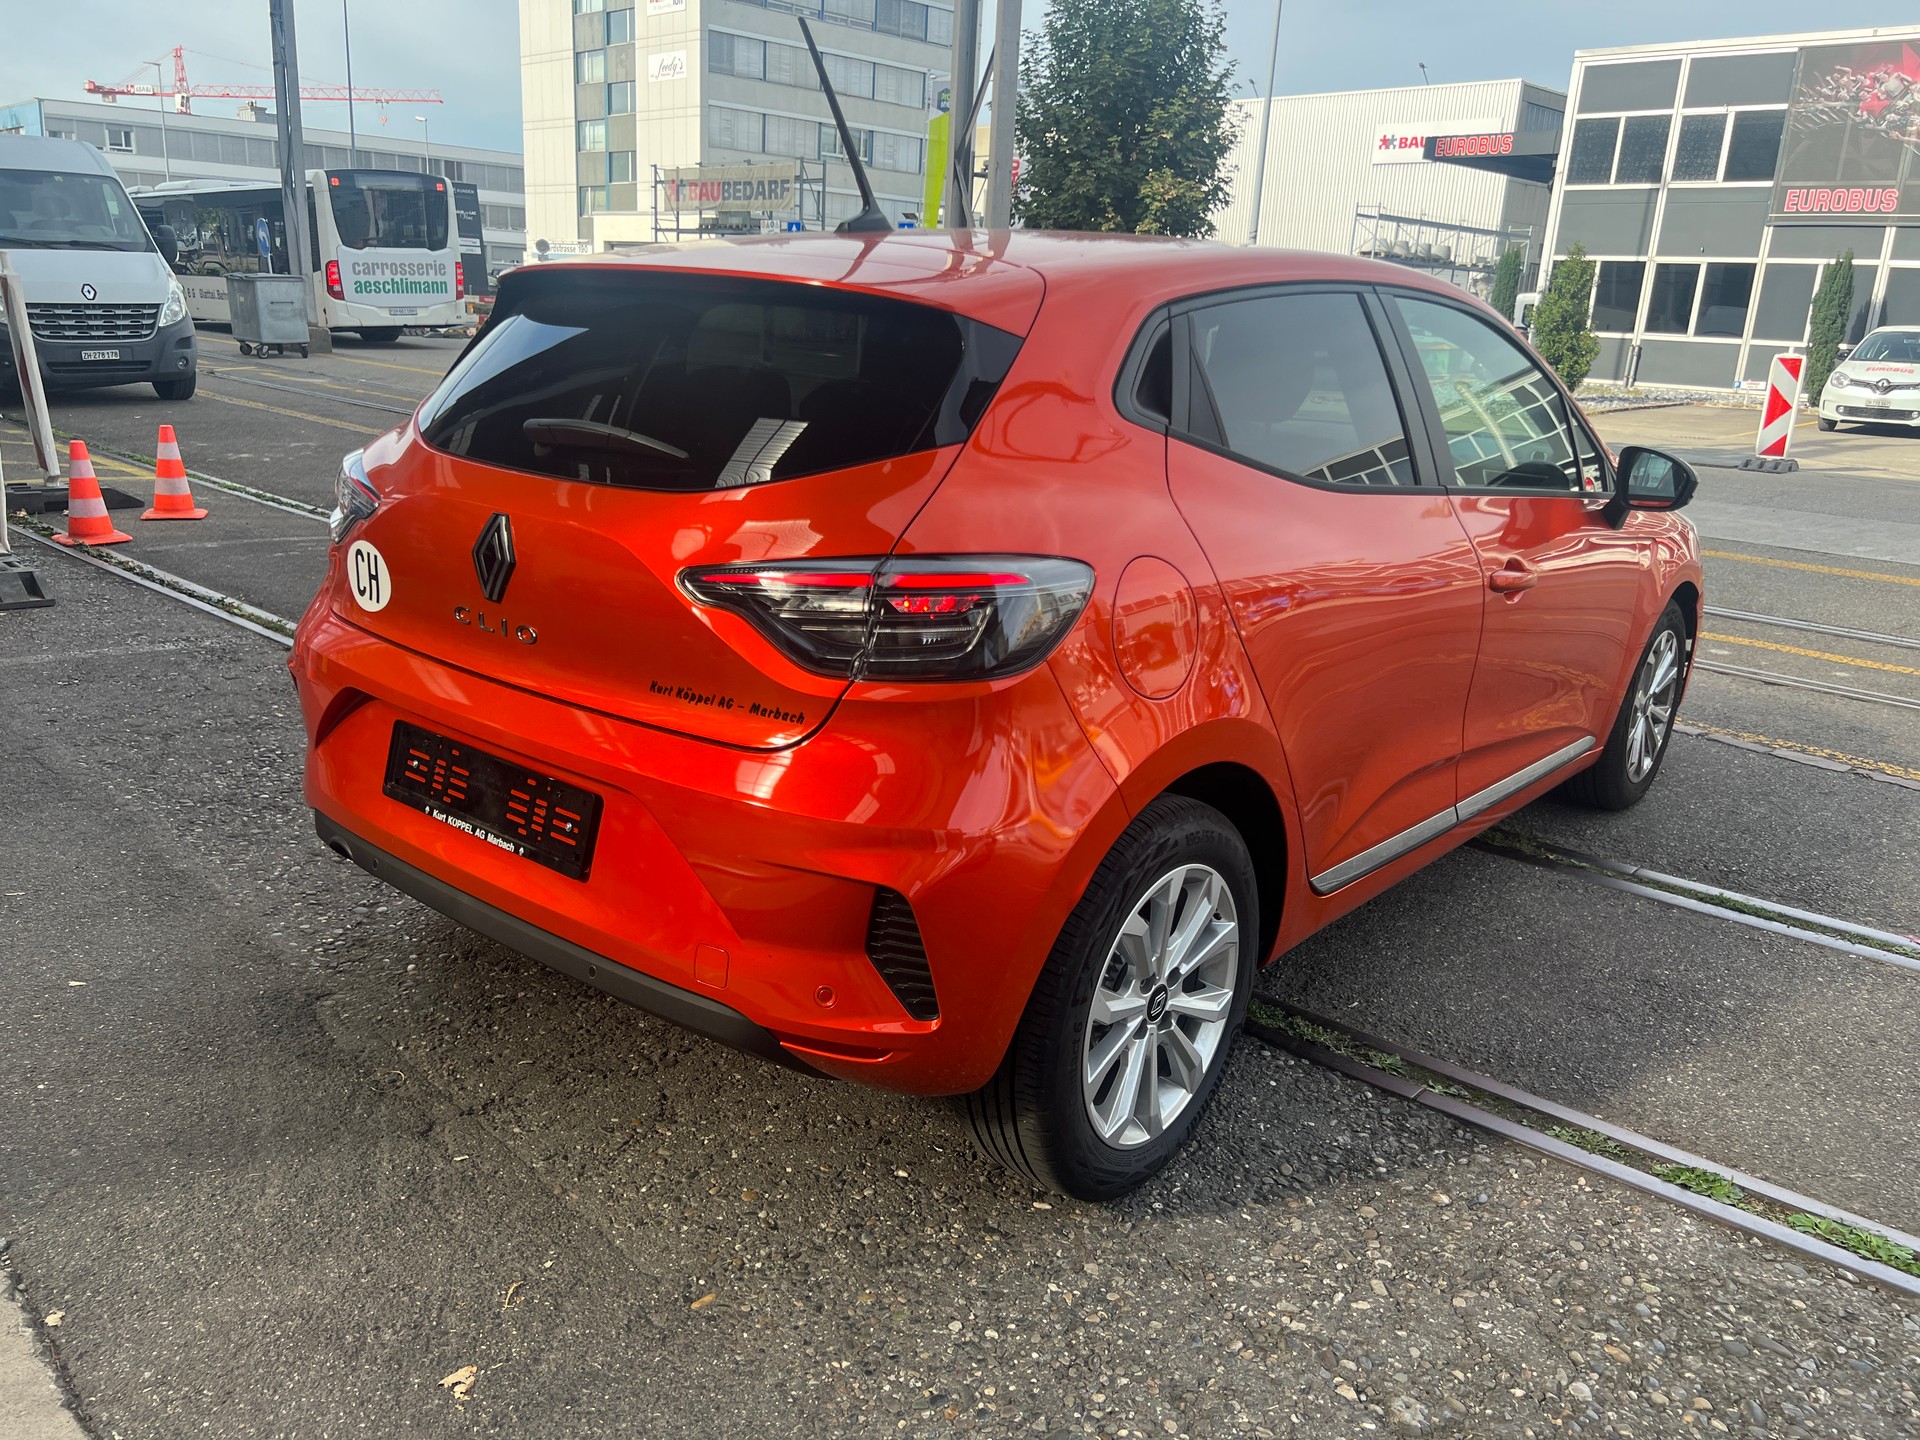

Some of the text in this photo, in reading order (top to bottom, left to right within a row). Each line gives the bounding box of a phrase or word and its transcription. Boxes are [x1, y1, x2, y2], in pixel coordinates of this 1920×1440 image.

[1435, 134, 1514, 157] EUROBUS
[688, 179, 790, 202] BAUBEDARF
[1784, 188, 1899, 212] EUROBUS
[549, 243, 577, 253] rdstrasse
[352, 260, 447, 276] carrosserie
[354, 278, 448, 294] aeschlimann
[1866, 366, 1915, 375] EUROBUS
[355, 548, 380, 604] CH
[454, 606, 538, 645] CLIO
[650, 680, 674, 697] Kurt
[675, 687, 716, 706] Köppel
[717, 695, 735, 710] AG
[749, 702, 806, 725] Marbach
[432, 809, 447, 823] Kurt
[474, 828, 486, 839] AG
[486, 832, 515, 852] Marbach
